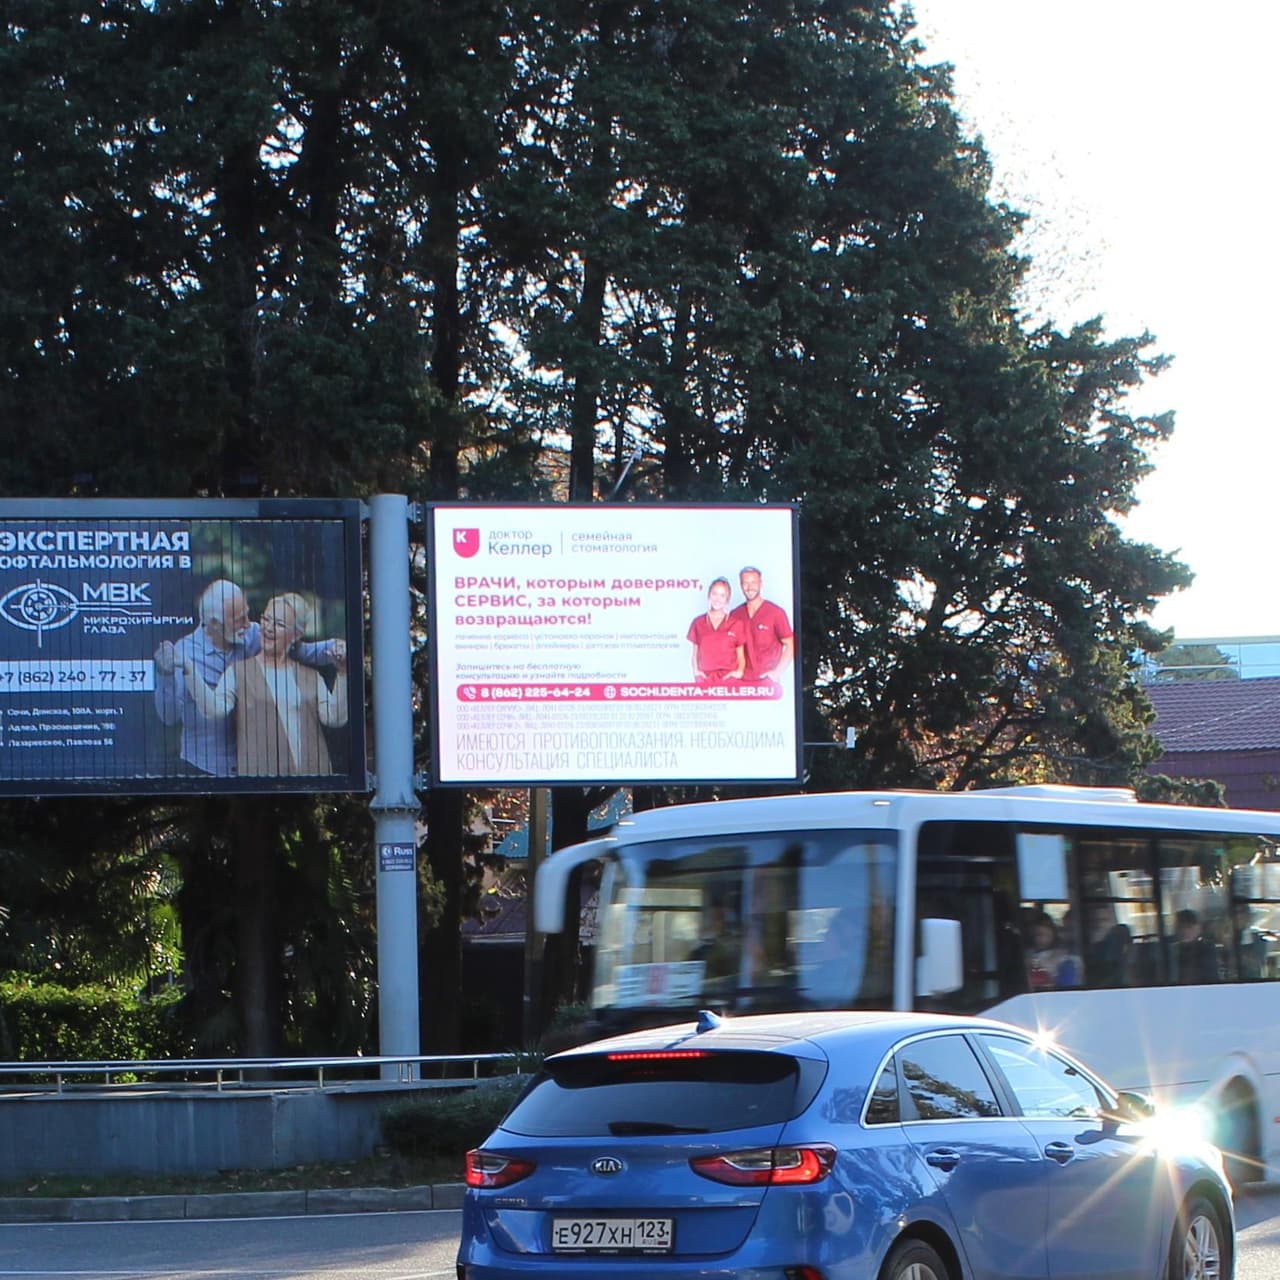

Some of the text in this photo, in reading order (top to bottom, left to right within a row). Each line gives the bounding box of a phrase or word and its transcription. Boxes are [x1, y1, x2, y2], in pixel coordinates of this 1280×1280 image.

[488, 530, 532, 541] доктор
[571, 531, 632, 541] семейная
[488, 542, 552, 558] Келлер
[571, 543, 658, 553] стоматология
[179, 555, 192, 569] В
[455, 576, 703, 591] ВРАЧИ, которым доверяют,
[83, 582, 151, 601] МВК
[455, 594, 641, 609] СЕРВИС, за которым
[83, 616, 193, 625] МИКРОХИРУРГИИ
[455, 613, 592, 628] возвращаются!
[83, 626, 127, 634] ГЛАЗА
[456, 663, 511, 671] Запишитесь
[527, 663, 581, 671] бесплатную
[18, 670, 54, 685] (862)
[58, 671, 86, 682] 240
[98, 671, 116, 683] 77
[129, 671, 146, 682] 37
[481, 686, 774, 699] 8 (862) 225-64-24 SOCHI.DENTA-KELLER.RU
[456, 732, 526, 751] ИМЕЮТСЯ
[690, 731, 785, 751] НЕОБХОДИМА
[456, 751, 678, 771] КОНСУЛЬТАЦИЯ СПЕЦИАЛИСТА
[595, 1161, 617, 1172] KIA
[558, 1221, 666, 1244] Е927ХН 123
